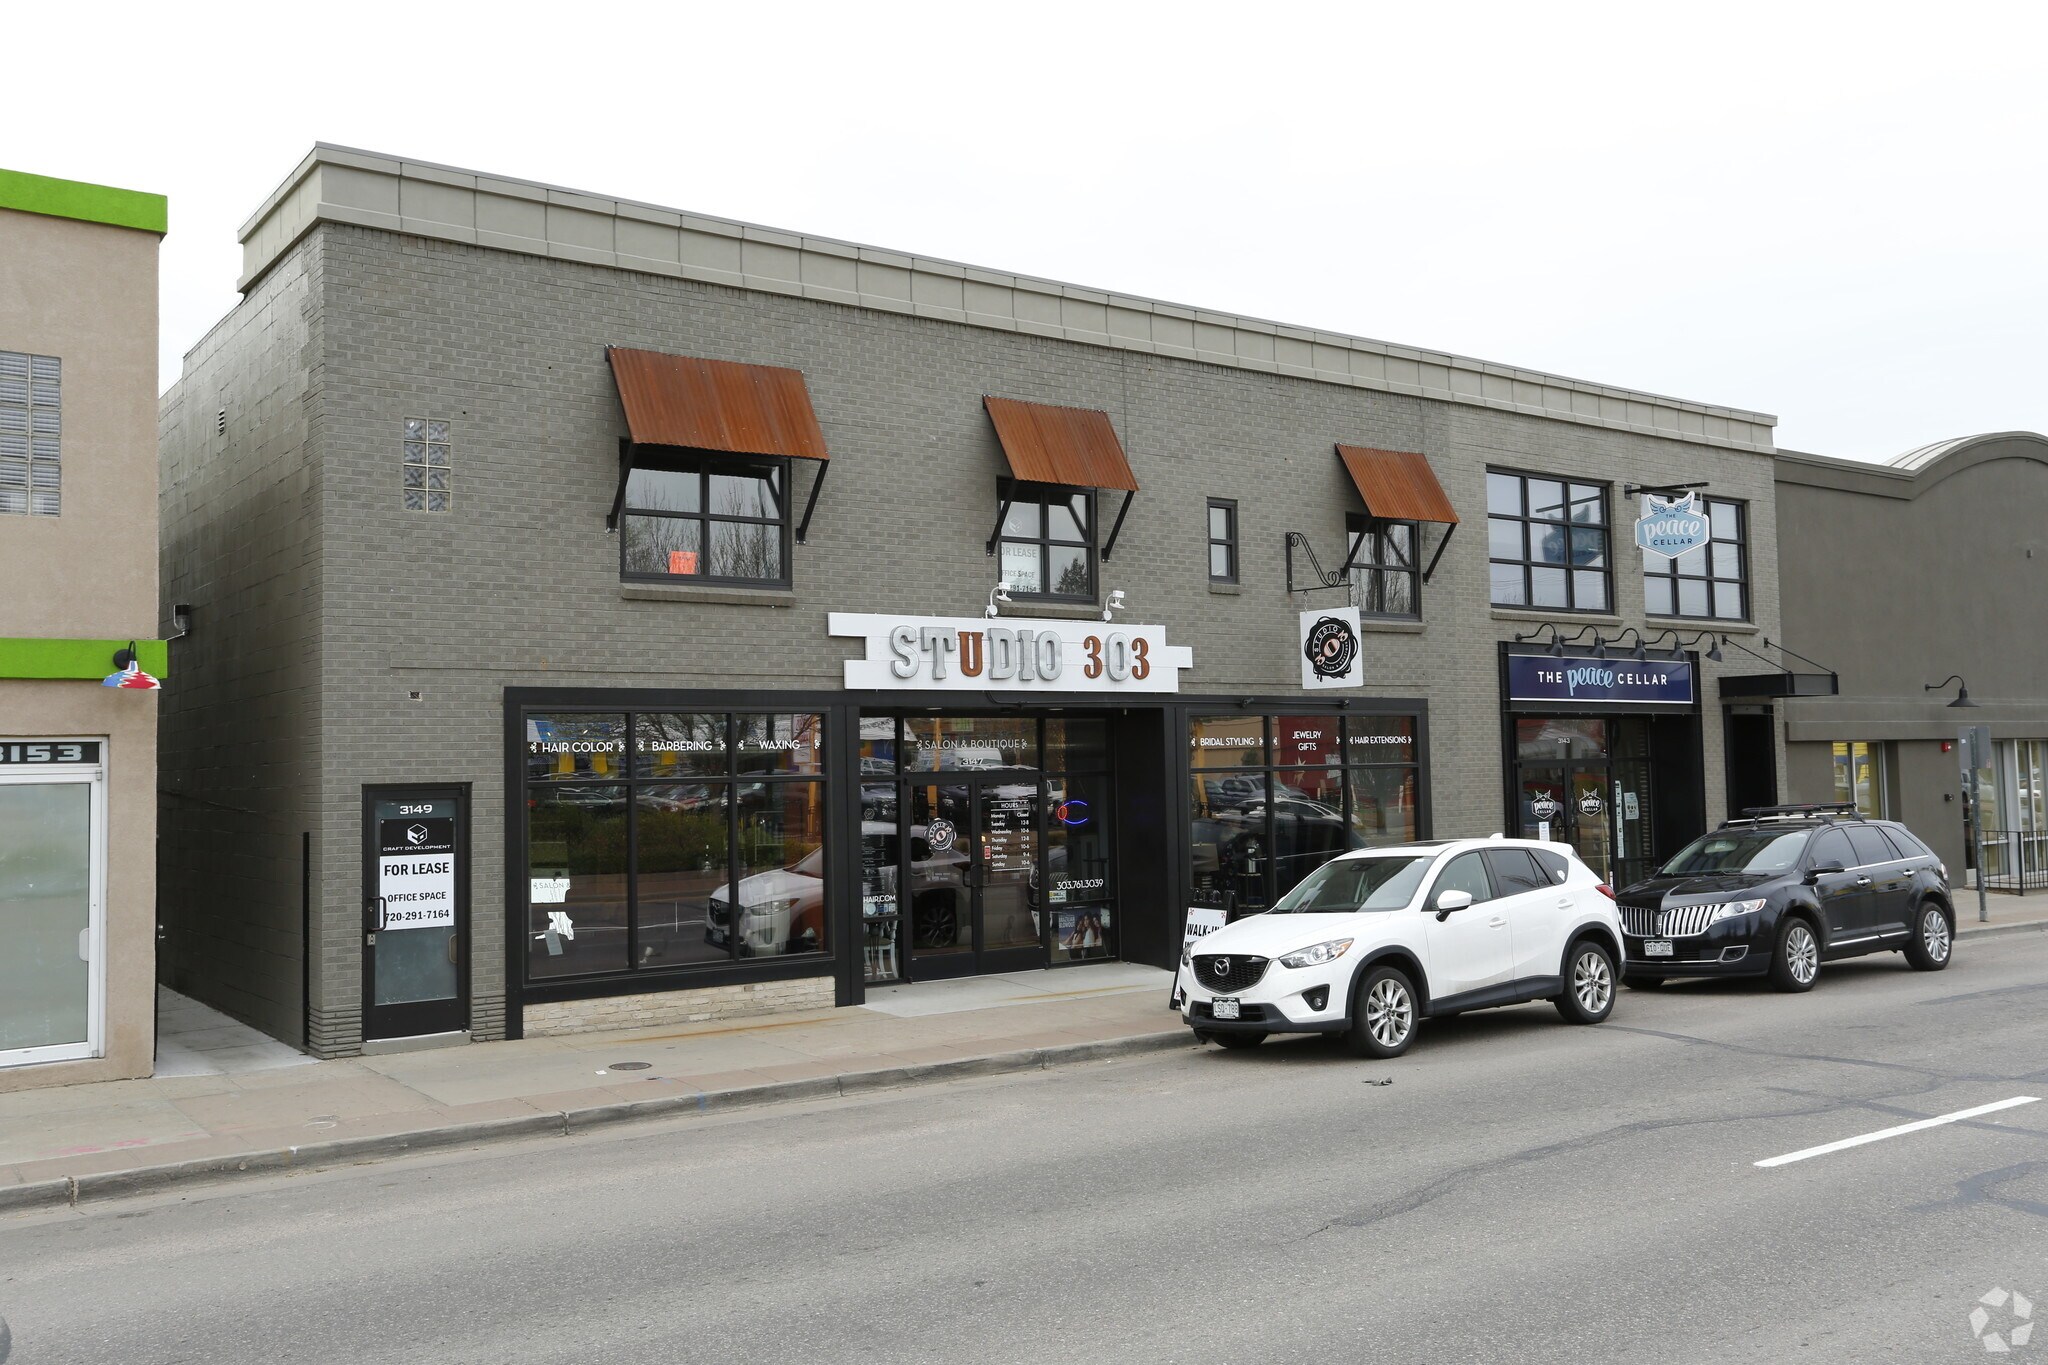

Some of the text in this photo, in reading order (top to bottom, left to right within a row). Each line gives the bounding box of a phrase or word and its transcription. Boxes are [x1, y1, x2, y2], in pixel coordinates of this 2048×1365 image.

[1643, 518, 1701, 546] peace
[1653, 537, 1693, 546] CELLAR
[1001, 546, 1037, 558] OR LEASE
[1001, 569, 1035, 578] FFICE SPACE
[1313, 625, 1339, 653] STUDIO
[890, 625, 1150, 682] STUDIO 303
[1538, 667, 1668, 696] THE peace CELLAR
[1292, 731, 1322, 739] JEWELRY
[1354, 735, 1407, 744] HAIR EXTENSIONS
[542, 741, 613, 753] HAIR COLOR
[652, 740, 713, 751] BARBERING
[759, 739, 801, 750] WAXING
[925, 739, 1020, 750] SALON & BOUTIQUE
[1200, 737, 1255, 746] BRIDAL STYLING
[1297, 742, 1317, 751] GIFTS
[0, 745, 82, 762] 153
[400, 804, 432, 815] 3149
[1534, 800, 1554, 812] peace
[1581, 799, 1600, 811] peace
[384, 862, 450, 877] FOR LEASE
[387, 891, 447, 903] OFFICE SPACE
[385, 909, 450, 922] 720-291-7164
